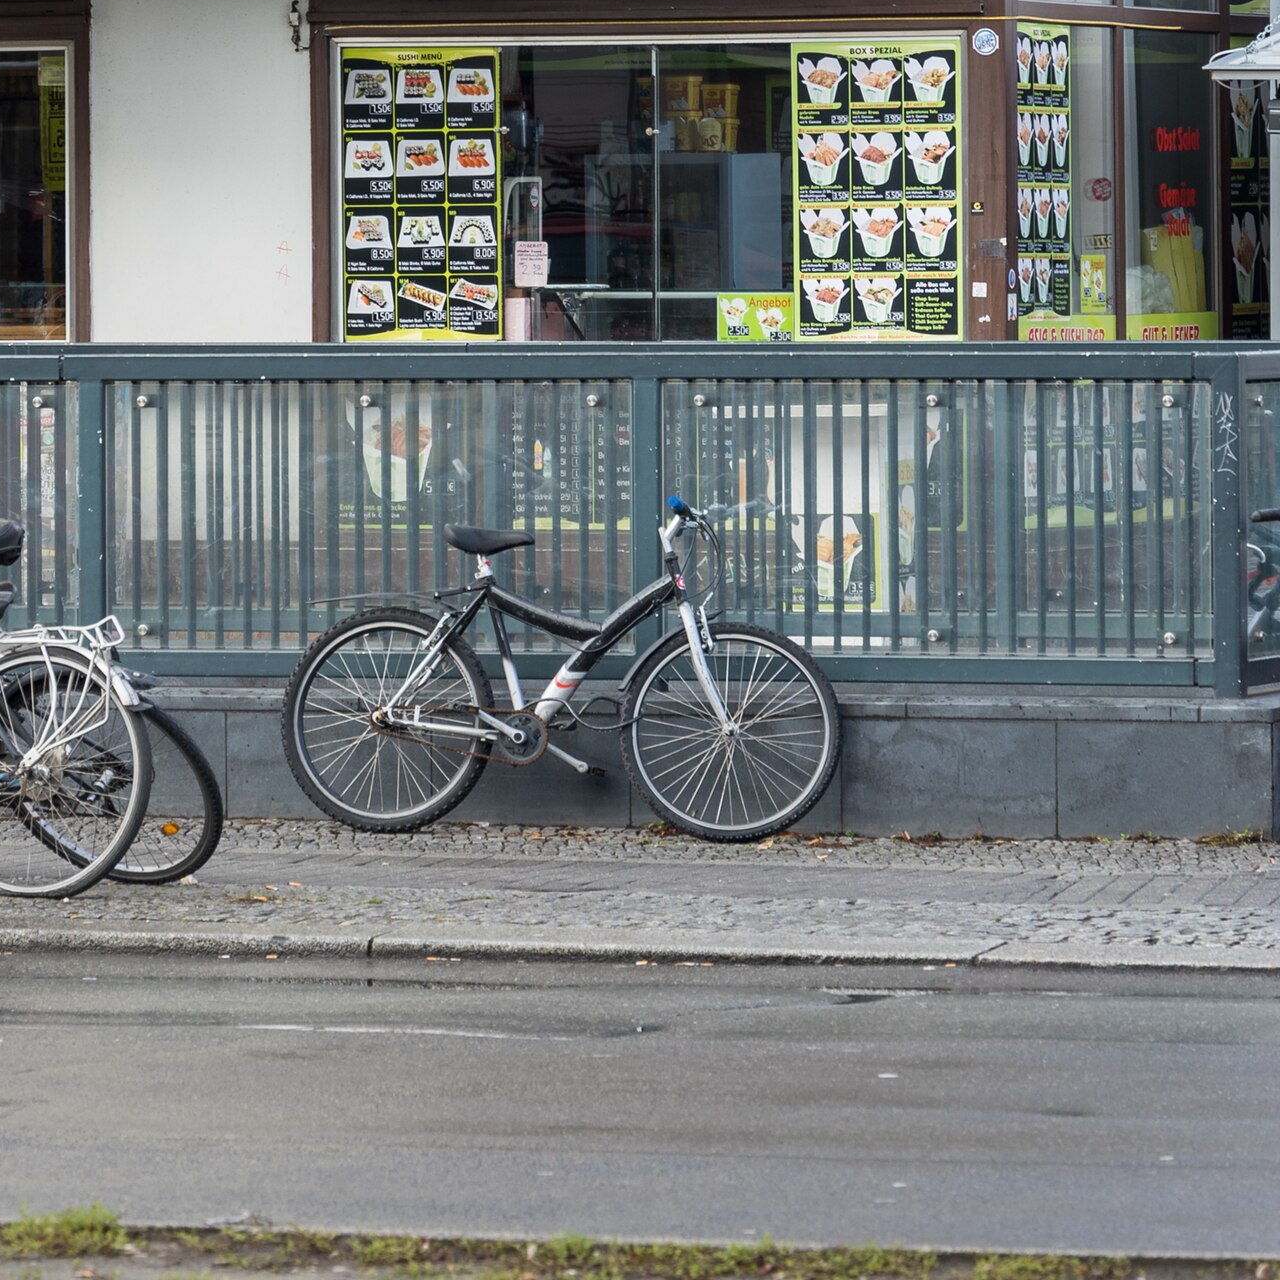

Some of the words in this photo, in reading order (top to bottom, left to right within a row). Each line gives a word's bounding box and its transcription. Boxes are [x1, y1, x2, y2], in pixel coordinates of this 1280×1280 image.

[397, 53, 419, 61] SUSHI
[473, 102, 494, 111] 6.50€
[372, 181, 392, 191] 5.50€
[423, 180, 443, 190] 5.50€
[474, 180, 495, 190] 6.90€
[372, 249, 393, 260] 8.50€
[424, 249, 444, 259] 5.90€
[475, 248, 495, 258] 8.00€
[748, 296, 791, 310] Angebot
[426, 310, 446, 321] 5.90€
[728, 326, 749, 336] 2.50€
[1142, 327, 1158, 341] GUT
[770, 332, 792, 342] 2.90€
